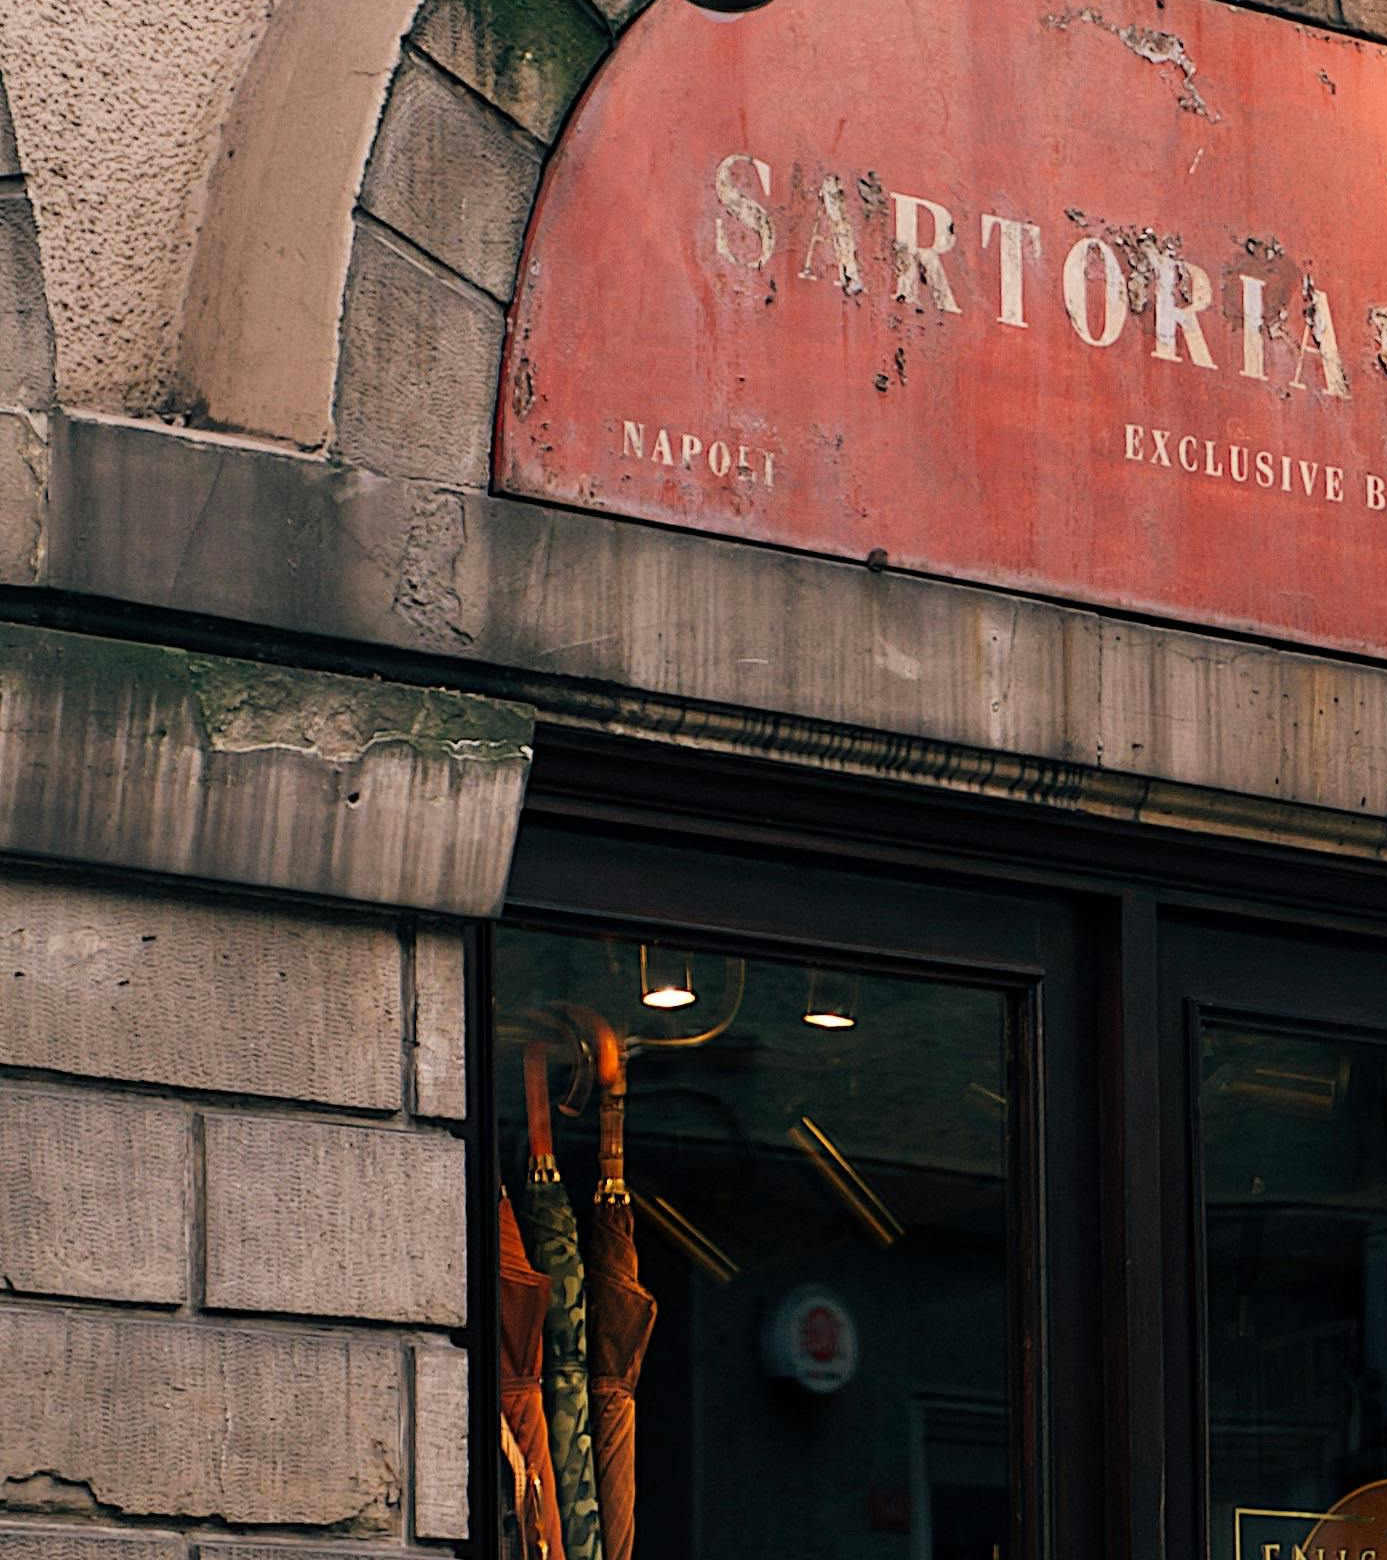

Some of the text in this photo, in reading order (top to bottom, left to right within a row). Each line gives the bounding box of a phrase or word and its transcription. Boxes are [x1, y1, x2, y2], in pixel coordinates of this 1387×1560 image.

[711, 153, 1352, 400] SARTORIA
[622, 419, 776, 488] NAPOLI
[1123, 423, 1344, 503] EXCLUSIVE
